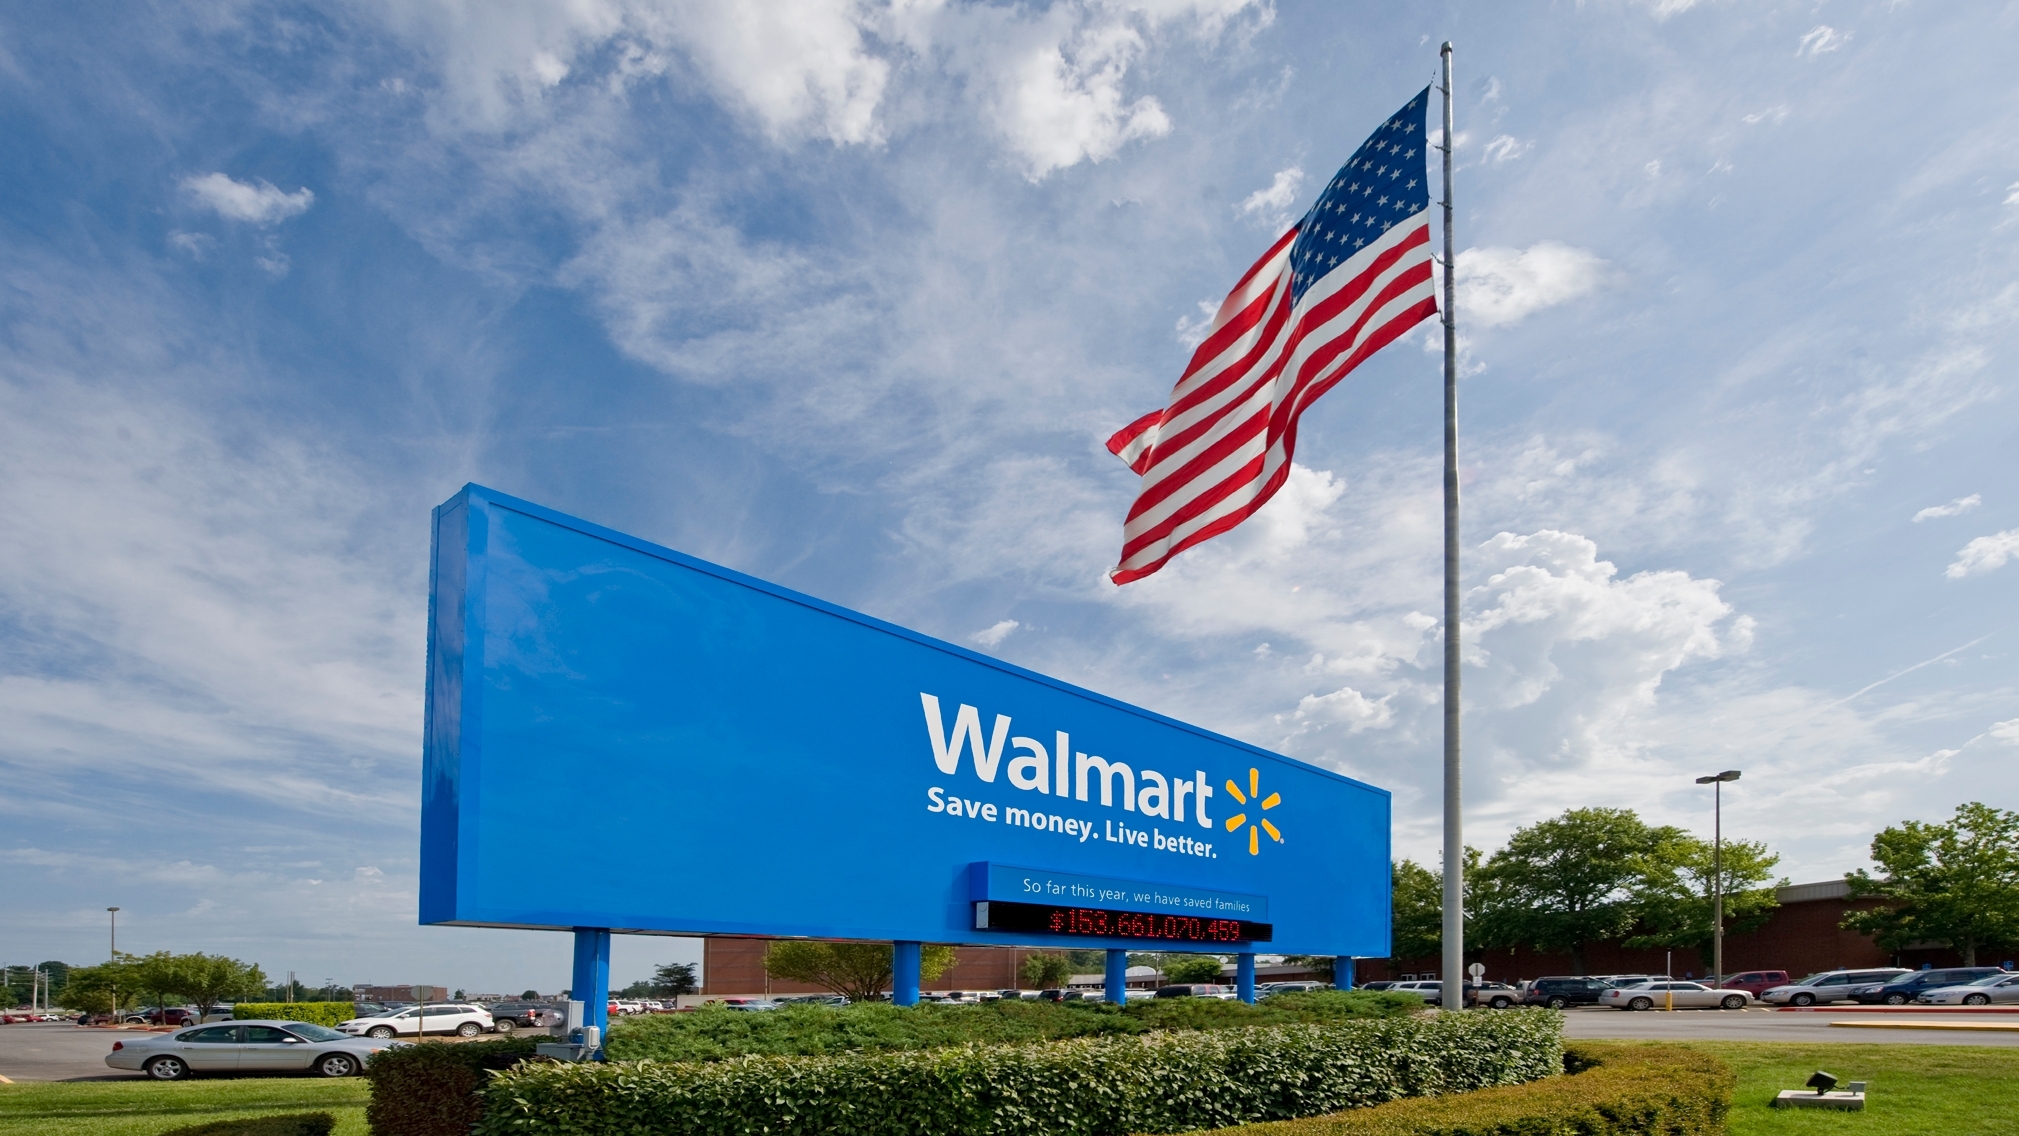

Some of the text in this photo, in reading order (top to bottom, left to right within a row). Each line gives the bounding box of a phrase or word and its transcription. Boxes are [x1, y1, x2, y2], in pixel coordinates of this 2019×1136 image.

[919, 691, 1213, 829] Walmart
[927, 787, 1218, 860] Save money. Live better.
[1023, 878, 1251, 913] So far this year, we have saved families
[1049, 909, 1240, 941] $153,661,070,459
